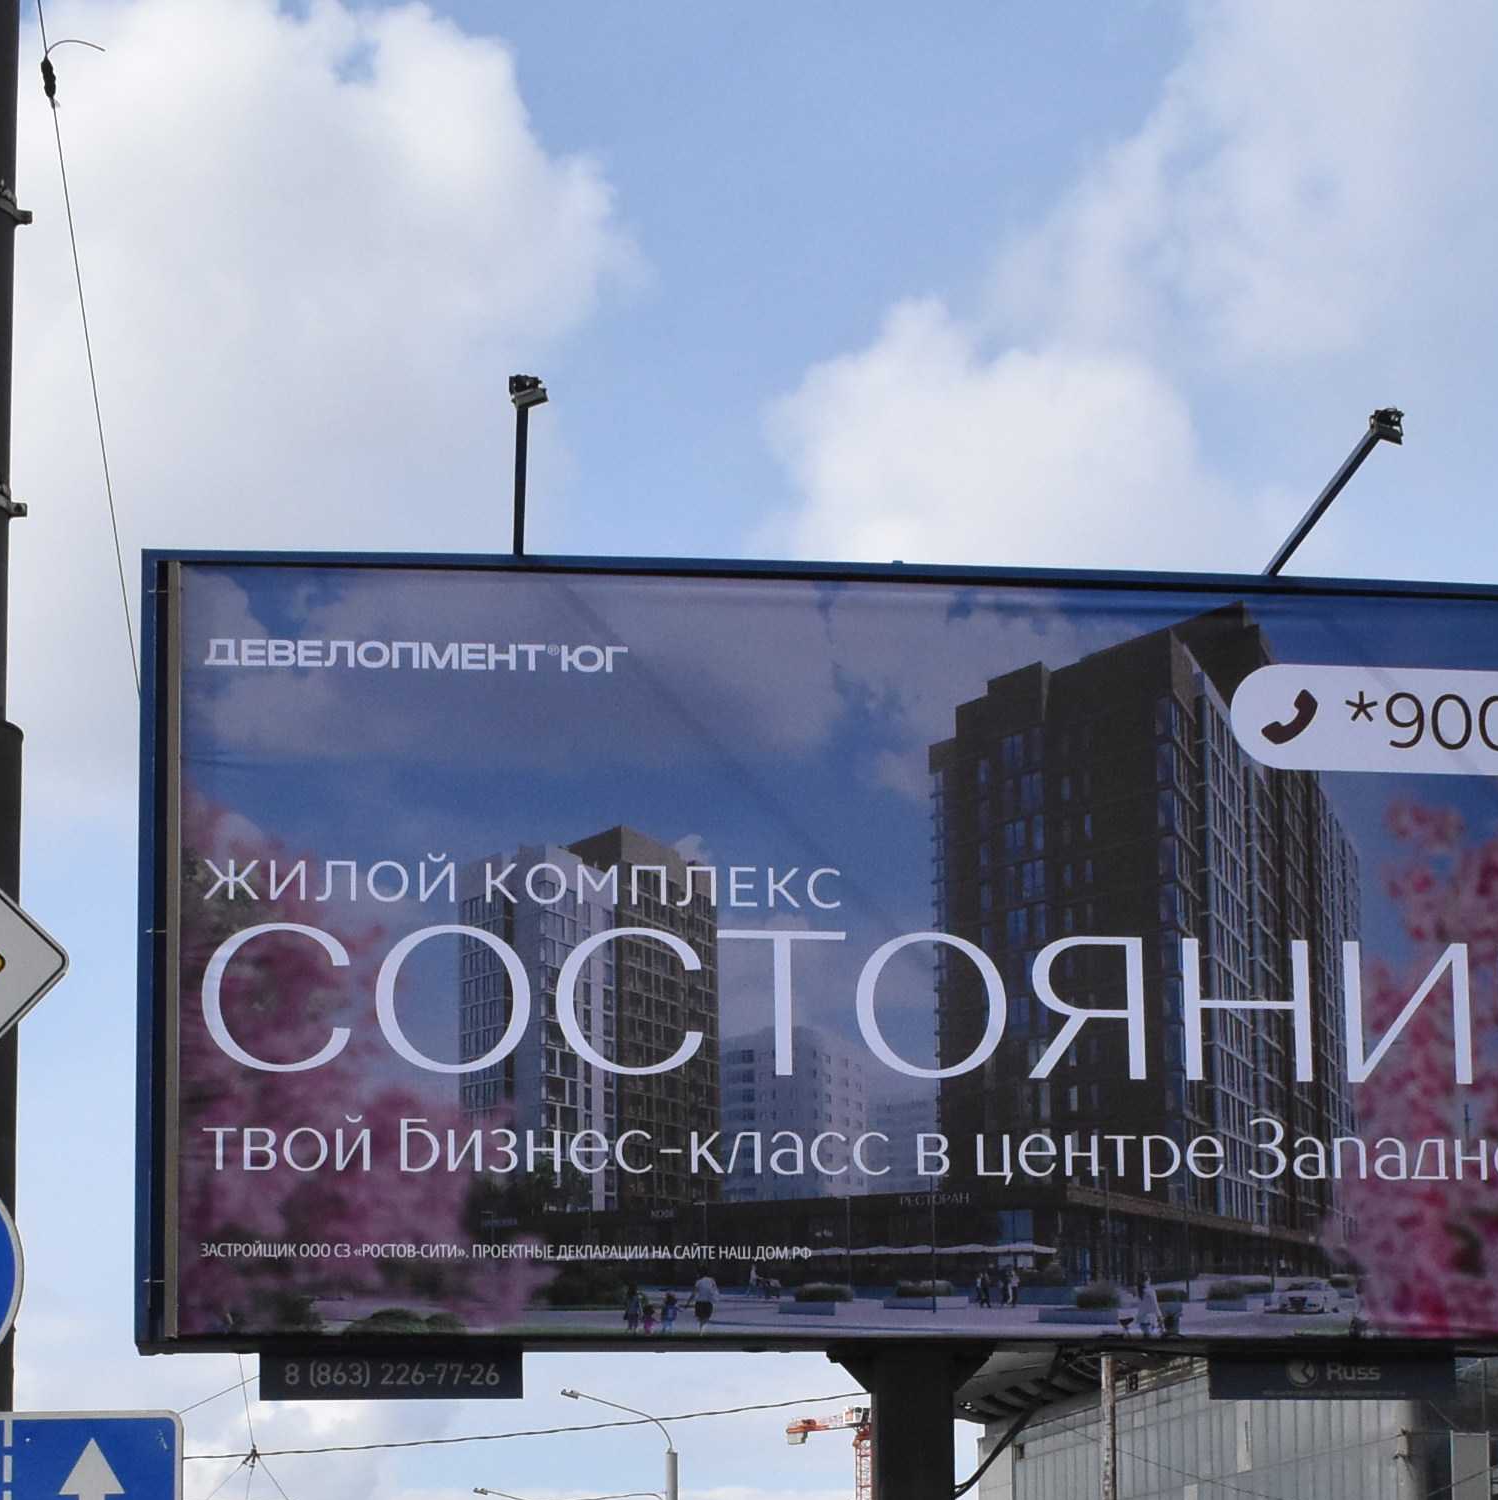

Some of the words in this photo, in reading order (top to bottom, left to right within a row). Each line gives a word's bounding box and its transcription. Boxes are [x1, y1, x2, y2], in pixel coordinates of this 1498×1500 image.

[561, 644, 629, 673] ЮГ
[202, 852, 456, 903] ЖИЛОЙ
[485, 861, 843, 910] КОМПЛЕКС
[202, 1114, 374, 1173] твой
[916, 1132, 951, 1176] в
[976, 1132, 1226, 1192] центре
[200, 1240, 297, 1259] ЗАСТРОЙЩИК
[300, 1243, 331, 1258] ООО
[472, 1243, 554, 1259] ПРОЕКТНЫЕ
[556, 1244, 650, 1261] ДЕКЛАРАЦИИ
[652, 1246, 672, 1260] НА
[673, 1243, 716, 1260] САЙТЕ
[718, 1245, 813, 1262] НАШ.ДОМ.РФ
[284, 1363, 301, 1386] 8
[309, 1360, 371, 1388] (863)
[380, 1362, 501, 1386] 226-77-26
[1326, 1361, 1382, 1382] Russ
